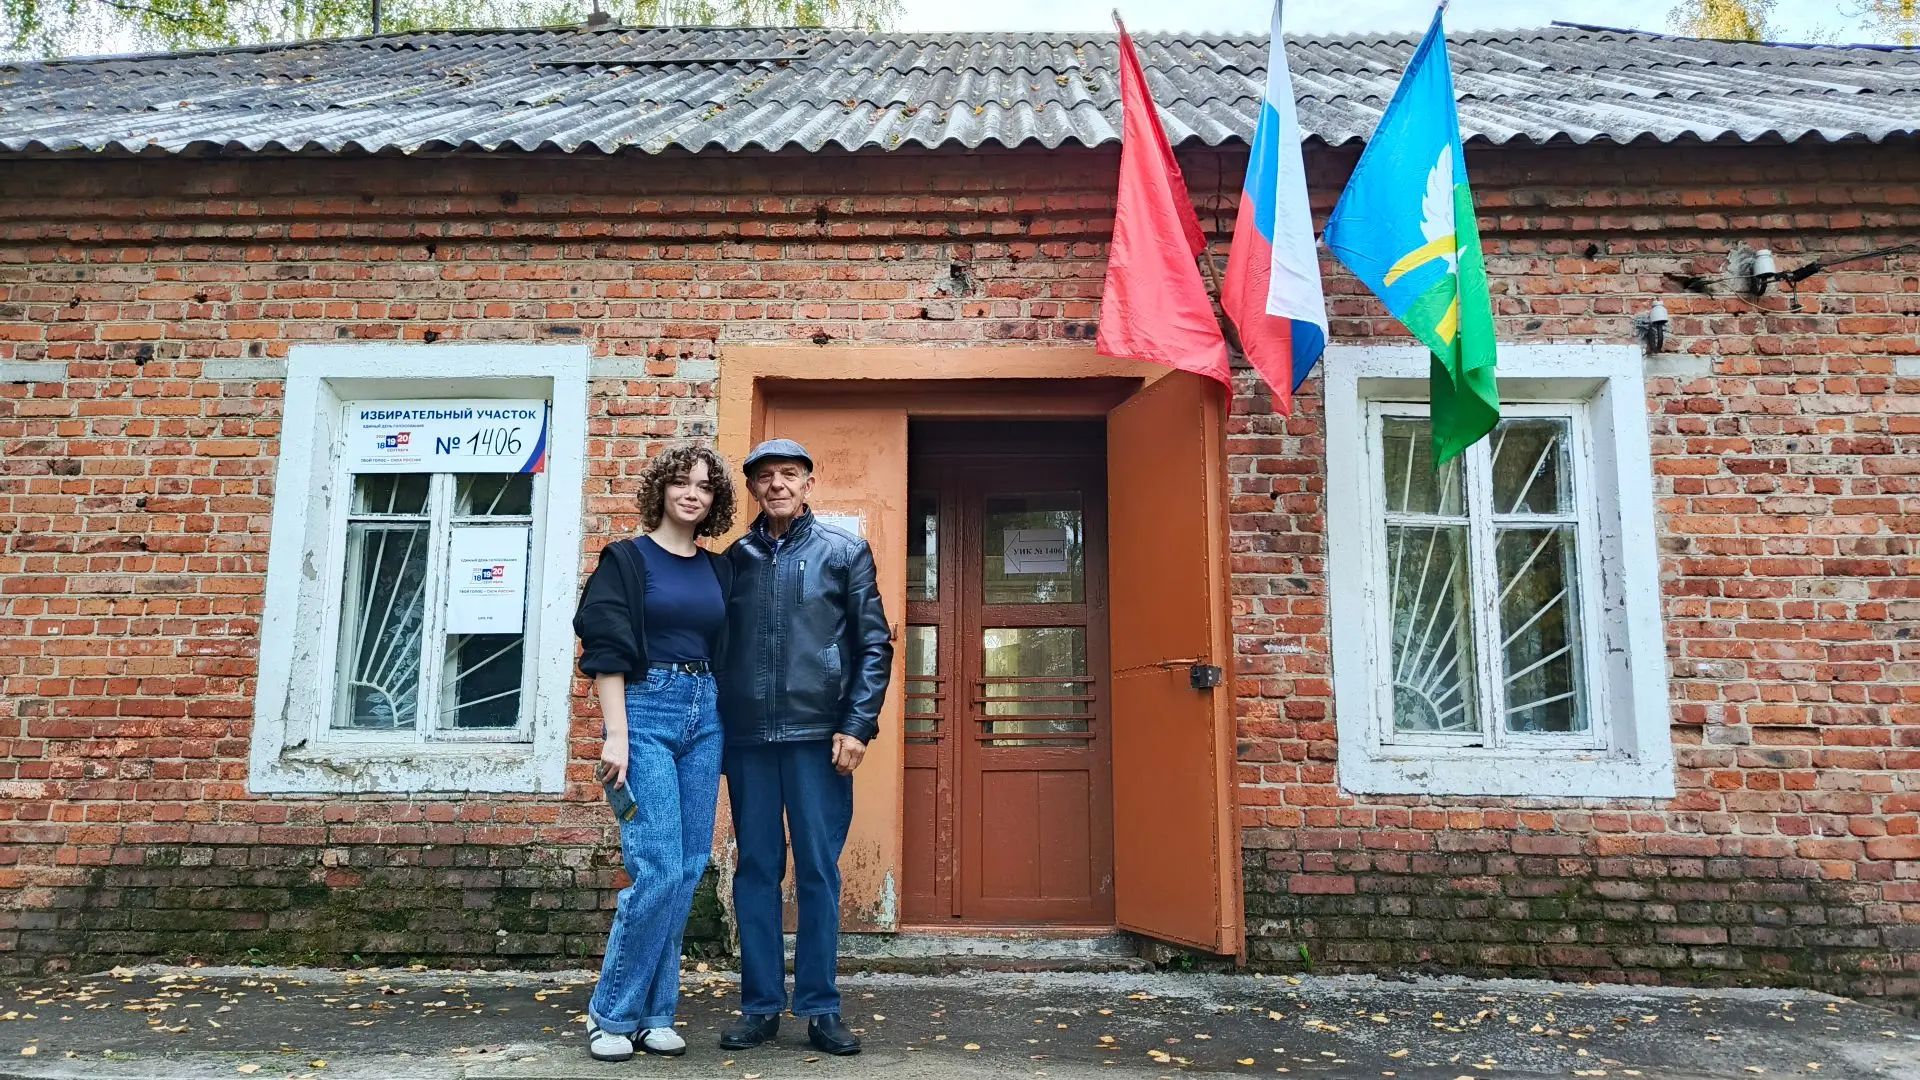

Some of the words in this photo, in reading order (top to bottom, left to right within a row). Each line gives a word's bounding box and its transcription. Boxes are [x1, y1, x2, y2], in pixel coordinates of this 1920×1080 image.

[361, 408, 473, 420] ИЗБИРАТЕЛЬНЫЙ
[477, 410, 536, 419] УЧАСТОК
[387, 437, 396, 446] 19
[397, 434, 409, 443] 20
[435, 436, 461, 455] №
[466, 427, 522, 455] 1406
[1034, 547, 1043, 555] №
[1045, 547, 1063, 555] 1406
[492, 567, 503, 575] 20
